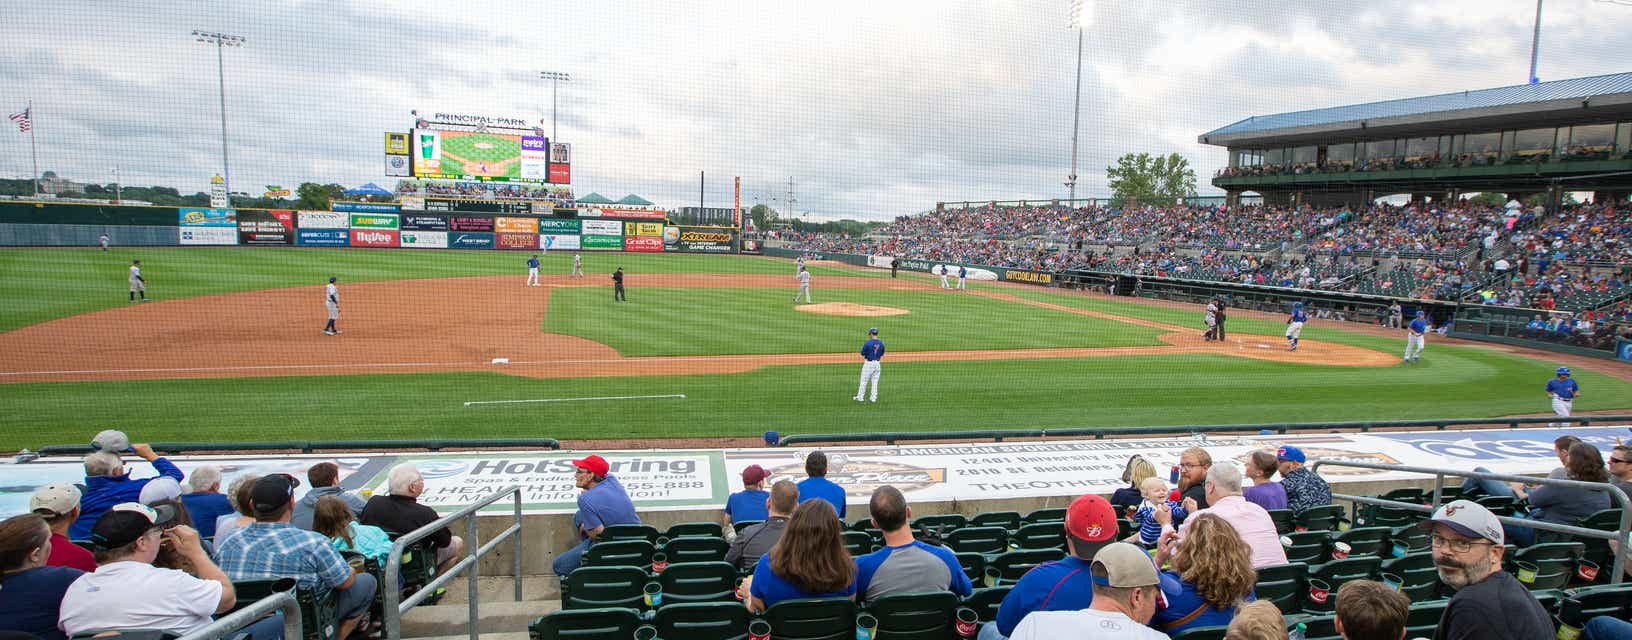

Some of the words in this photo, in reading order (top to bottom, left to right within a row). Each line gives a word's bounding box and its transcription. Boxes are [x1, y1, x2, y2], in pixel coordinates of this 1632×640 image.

[435, 112, 493, 124] PRINCIPAL
[497, 117, 526, 126] PARK
[356, 217, 393, 225] SUBWAY
[540, 220, 578, 228] MERCYONE
[681, 231, 731, 241] XTREAM
[899, 447, 996, 456] AMERICAN
[1016, 454, 1101, 463] University
[469, 459, 696, 475] HotSring
[1032, 464, 1113, 473] Delaware
[463, 477, 504, 485] Spas
[967, 478, 1124, 491] THEOTHER
